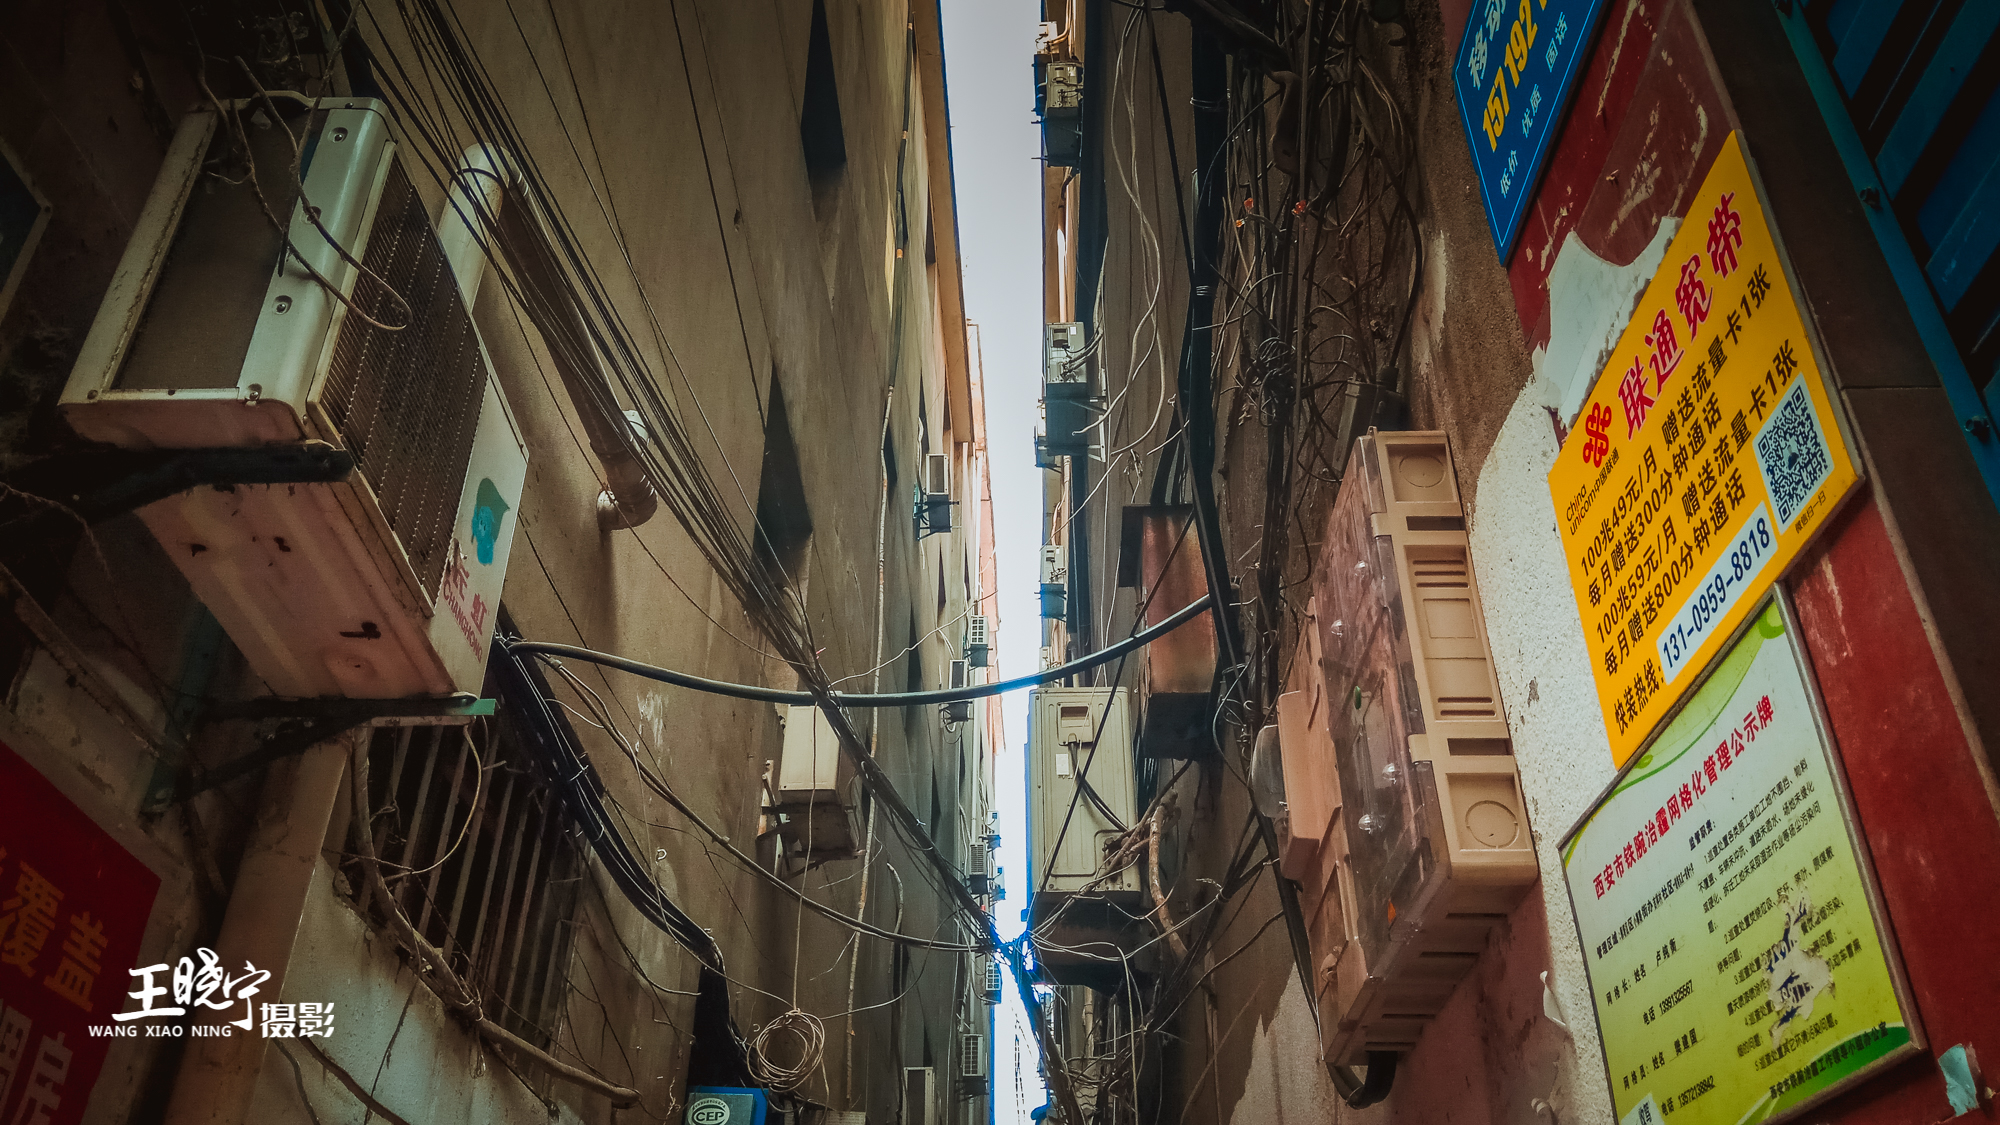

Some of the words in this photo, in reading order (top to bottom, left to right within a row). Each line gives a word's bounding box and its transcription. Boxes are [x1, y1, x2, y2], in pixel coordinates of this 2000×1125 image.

[1500, 149, 1519, 198] 低价
[1521, 83, 1542, 138] 优质
[1545, 12, 1568, 73] 固话
[1617, 191, 1746, 440] 联通宽带
[1566, 484, 1587, 522] China
[1580, 445, 1657, 578] 100兆49元/月
[1661, 262, 1772, 451] 赠送流量卡1张
[1587, 395, 1723, 609] 每月赠送300分钟通话
[1596, 516, 1678, 645] 100兆59元/月
[1681, 340, 1799, 525] 赠送流量卡1张
[1795, 490, 1826, 534] 微信扫一扫
[443, 579, 483, 664] CHANGHONG
[1603, 467, 1747, 678] 每月赠送800分钟通话
[1662, 517, 1771, 669] 131-0959-8818
[1592, 694, 1775, 901] 西安市铁腕治霾网格化管理公示牌
[0, 845, 109, 1012] 覆盖
[695, 1111, 725, 1122] CEP
